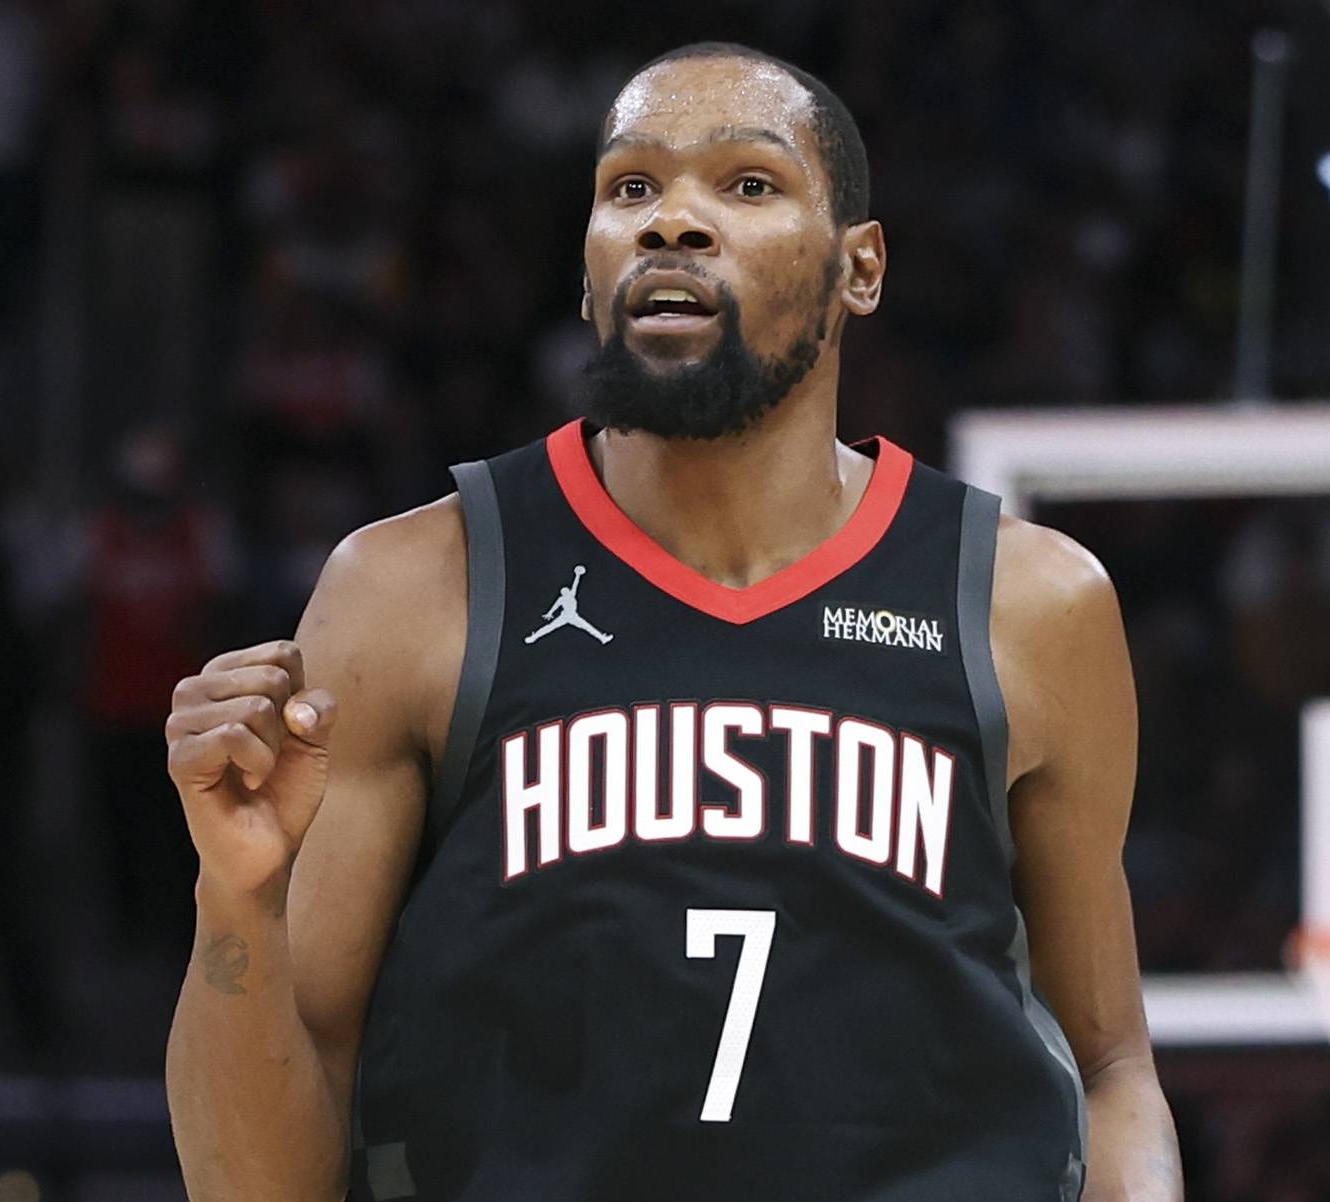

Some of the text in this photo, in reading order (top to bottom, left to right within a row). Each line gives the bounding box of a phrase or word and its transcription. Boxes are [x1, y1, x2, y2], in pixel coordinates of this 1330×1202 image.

[823, 606, 943, 637] MEMORIAL
[823, 620, 943, 652] HERMANN
[501, 701, 955, 900] HOUSTON
[686, 908, 776, 1122] 7
